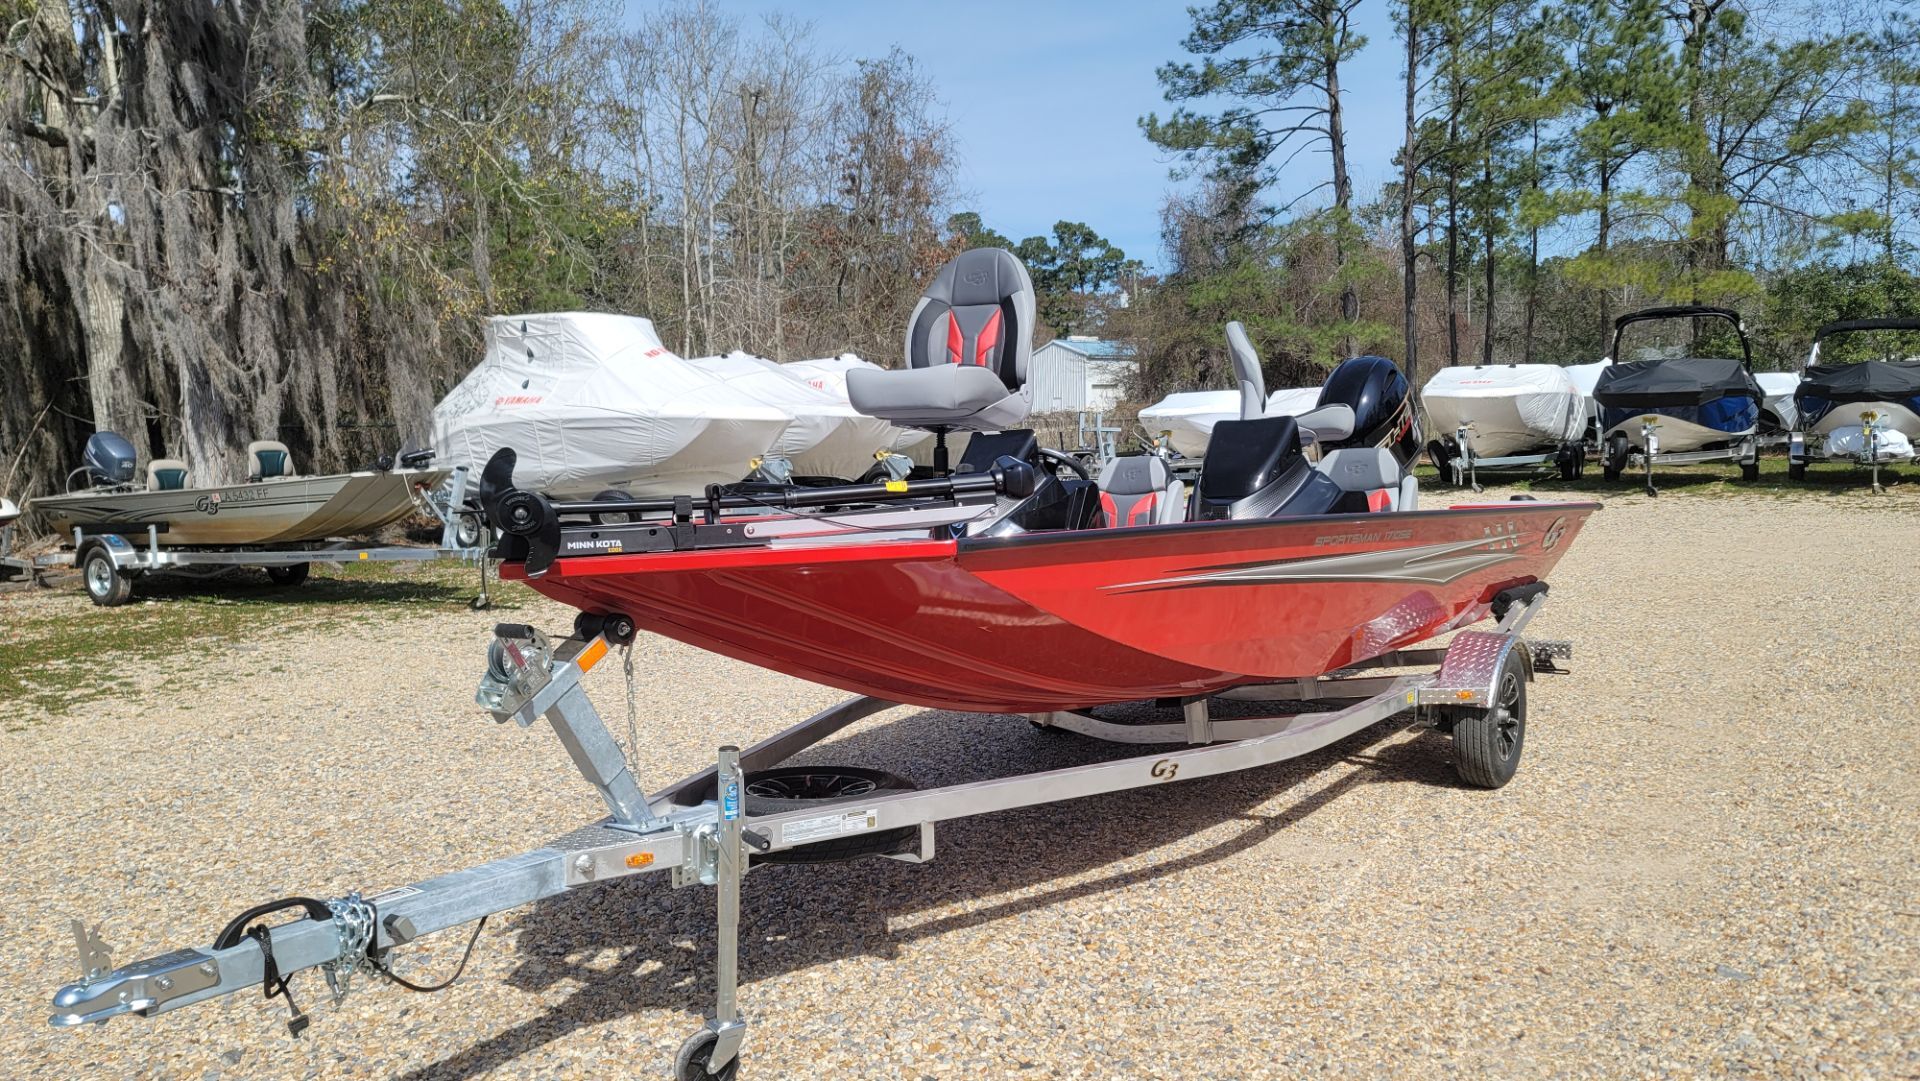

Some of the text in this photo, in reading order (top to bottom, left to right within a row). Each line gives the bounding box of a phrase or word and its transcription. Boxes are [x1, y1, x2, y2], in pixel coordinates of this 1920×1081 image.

[567, 540, 622, 549] MINN KOTA
[1314, 532, 1380, 547] SPORTSMAN
[1151, 758, 1179, 781] G3
